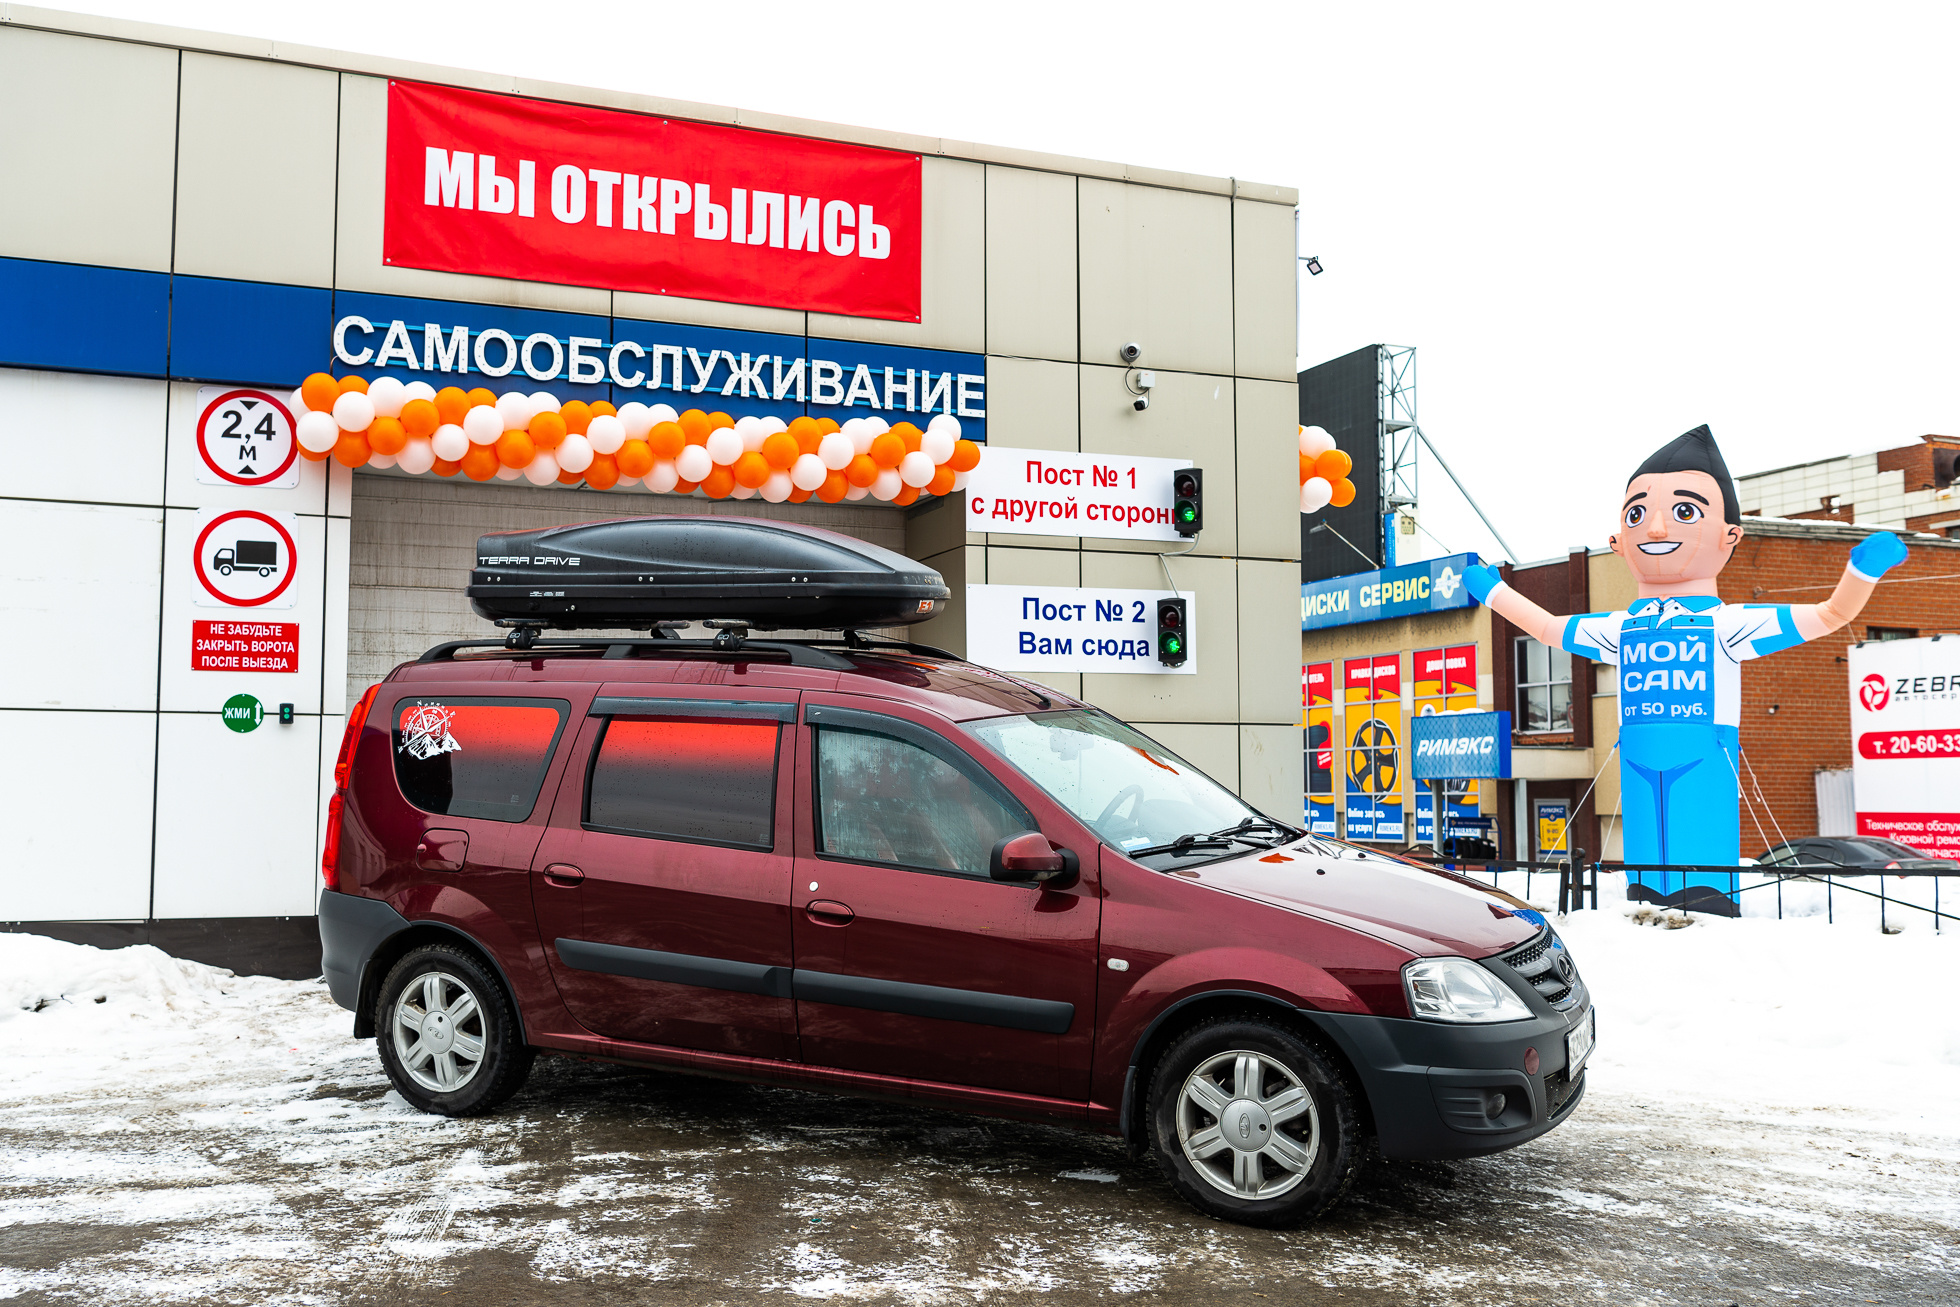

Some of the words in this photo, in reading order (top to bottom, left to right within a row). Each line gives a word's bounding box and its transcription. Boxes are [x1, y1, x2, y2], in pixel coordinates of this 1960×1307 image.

[424, 146, 536, 218] МЫ
[550, 163, 892, 260] ОТКРЫЛИСЬ
[333, 315, 986, 418] САМООБСЛУЖИВАНИЕ
[221, 410, 276, 444] 2,4
[1026, 461, 1084, 486] Пост
[1093, 465, 1118, 488] №
[1127, 467, 1136, 489] 1
[971, 496, 985, 515] с
[991, 495, 1078, 523] другой
[1086, 504, 1175, 528] сторон
[479, 556, 530, 565] TERRA
[534, 556, 581, 566] DRIVE
[1360, 576, 1430, 608] СЕРВИС
[1022, 597, 1086, 622] Пост
[1095, 600, 1123, 622] №
[1132, 600, 1146, 623] 2
[210, 623, 225, 635] НЕ
[227, 624, 282, 637] ЗАБУДЬТЕ
[196, 639, 248, 652] ЗАКРЫТЬ
[251, 641, 295, 653] ВОРОТА
[1019, 631, 1072, 655] Вам
[1082, 638, 1150, 661] сюда
[1623, 635, 1706, 665] МОЙ
[201, 656, 239, 668] ПОСЛЕ
[242, 657, 288, 670] ВЫЕЗДА
[1624, 669, 1706, 692] САМ
[224, 707, 251, 719] ЖМИ
[1624, 706, 1637, 717] от
[1641, 702, 1664, 715] 50
[1671, 702, 1708, 718] руб.
[1416, 736, 1495, 756] РИМЭКС
[1873, 741, 1886, 754] т.
[1865, 819, 1924, 831] Техническое
